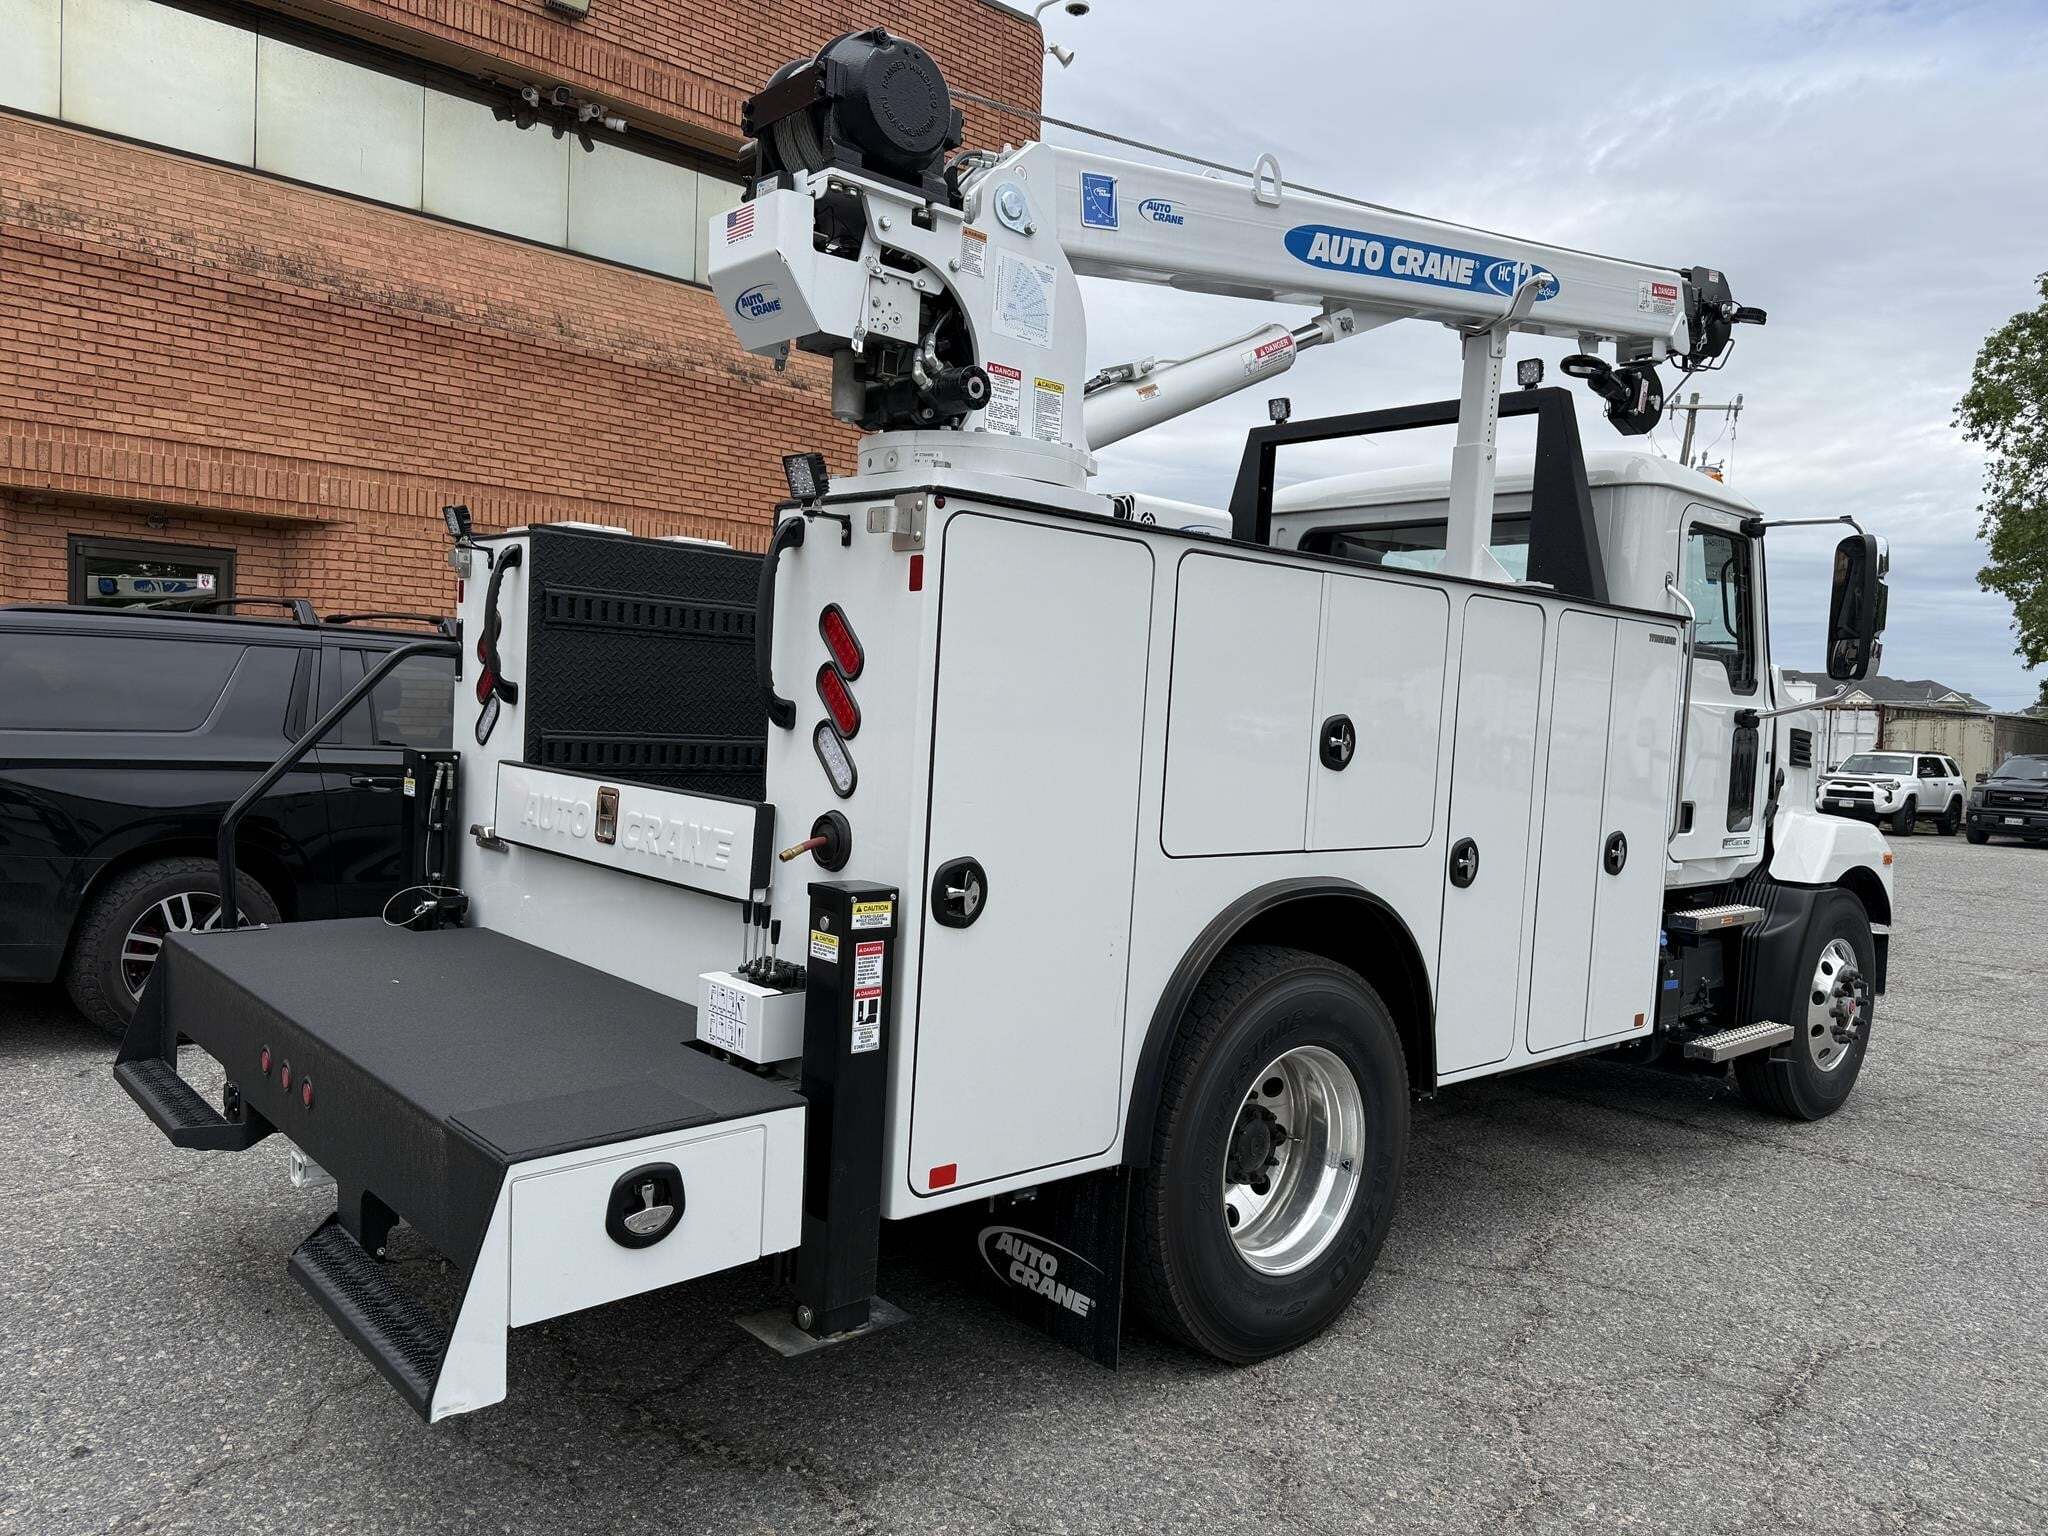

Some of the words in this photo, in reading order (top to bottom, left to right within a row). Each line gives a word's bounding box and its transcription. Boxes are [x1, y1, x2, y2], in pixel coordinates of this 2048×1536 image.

[1146, 201, 1171, 213] AUTO
[1153, 213, 1184, 225] CRANE
[1307, 232, 1384, 271] AUTO
[1390, 246, 1475, 285] CRANE
[741, 293, 764, 308] AUTO
[751, 299, 782, 316] CRANE
[994, 366, 1019, 378] DANGER
[1042, 382, 1063, 392] CAUTION
[520, 792, 591, 839] AUTO
[622, 810, 735, 872] CRANE
[863, 904, 889, 912] CAUTION
[995, 1232, 1058, 1277] AUTO
[1009, 1260, 1091, 1318] CRANE
